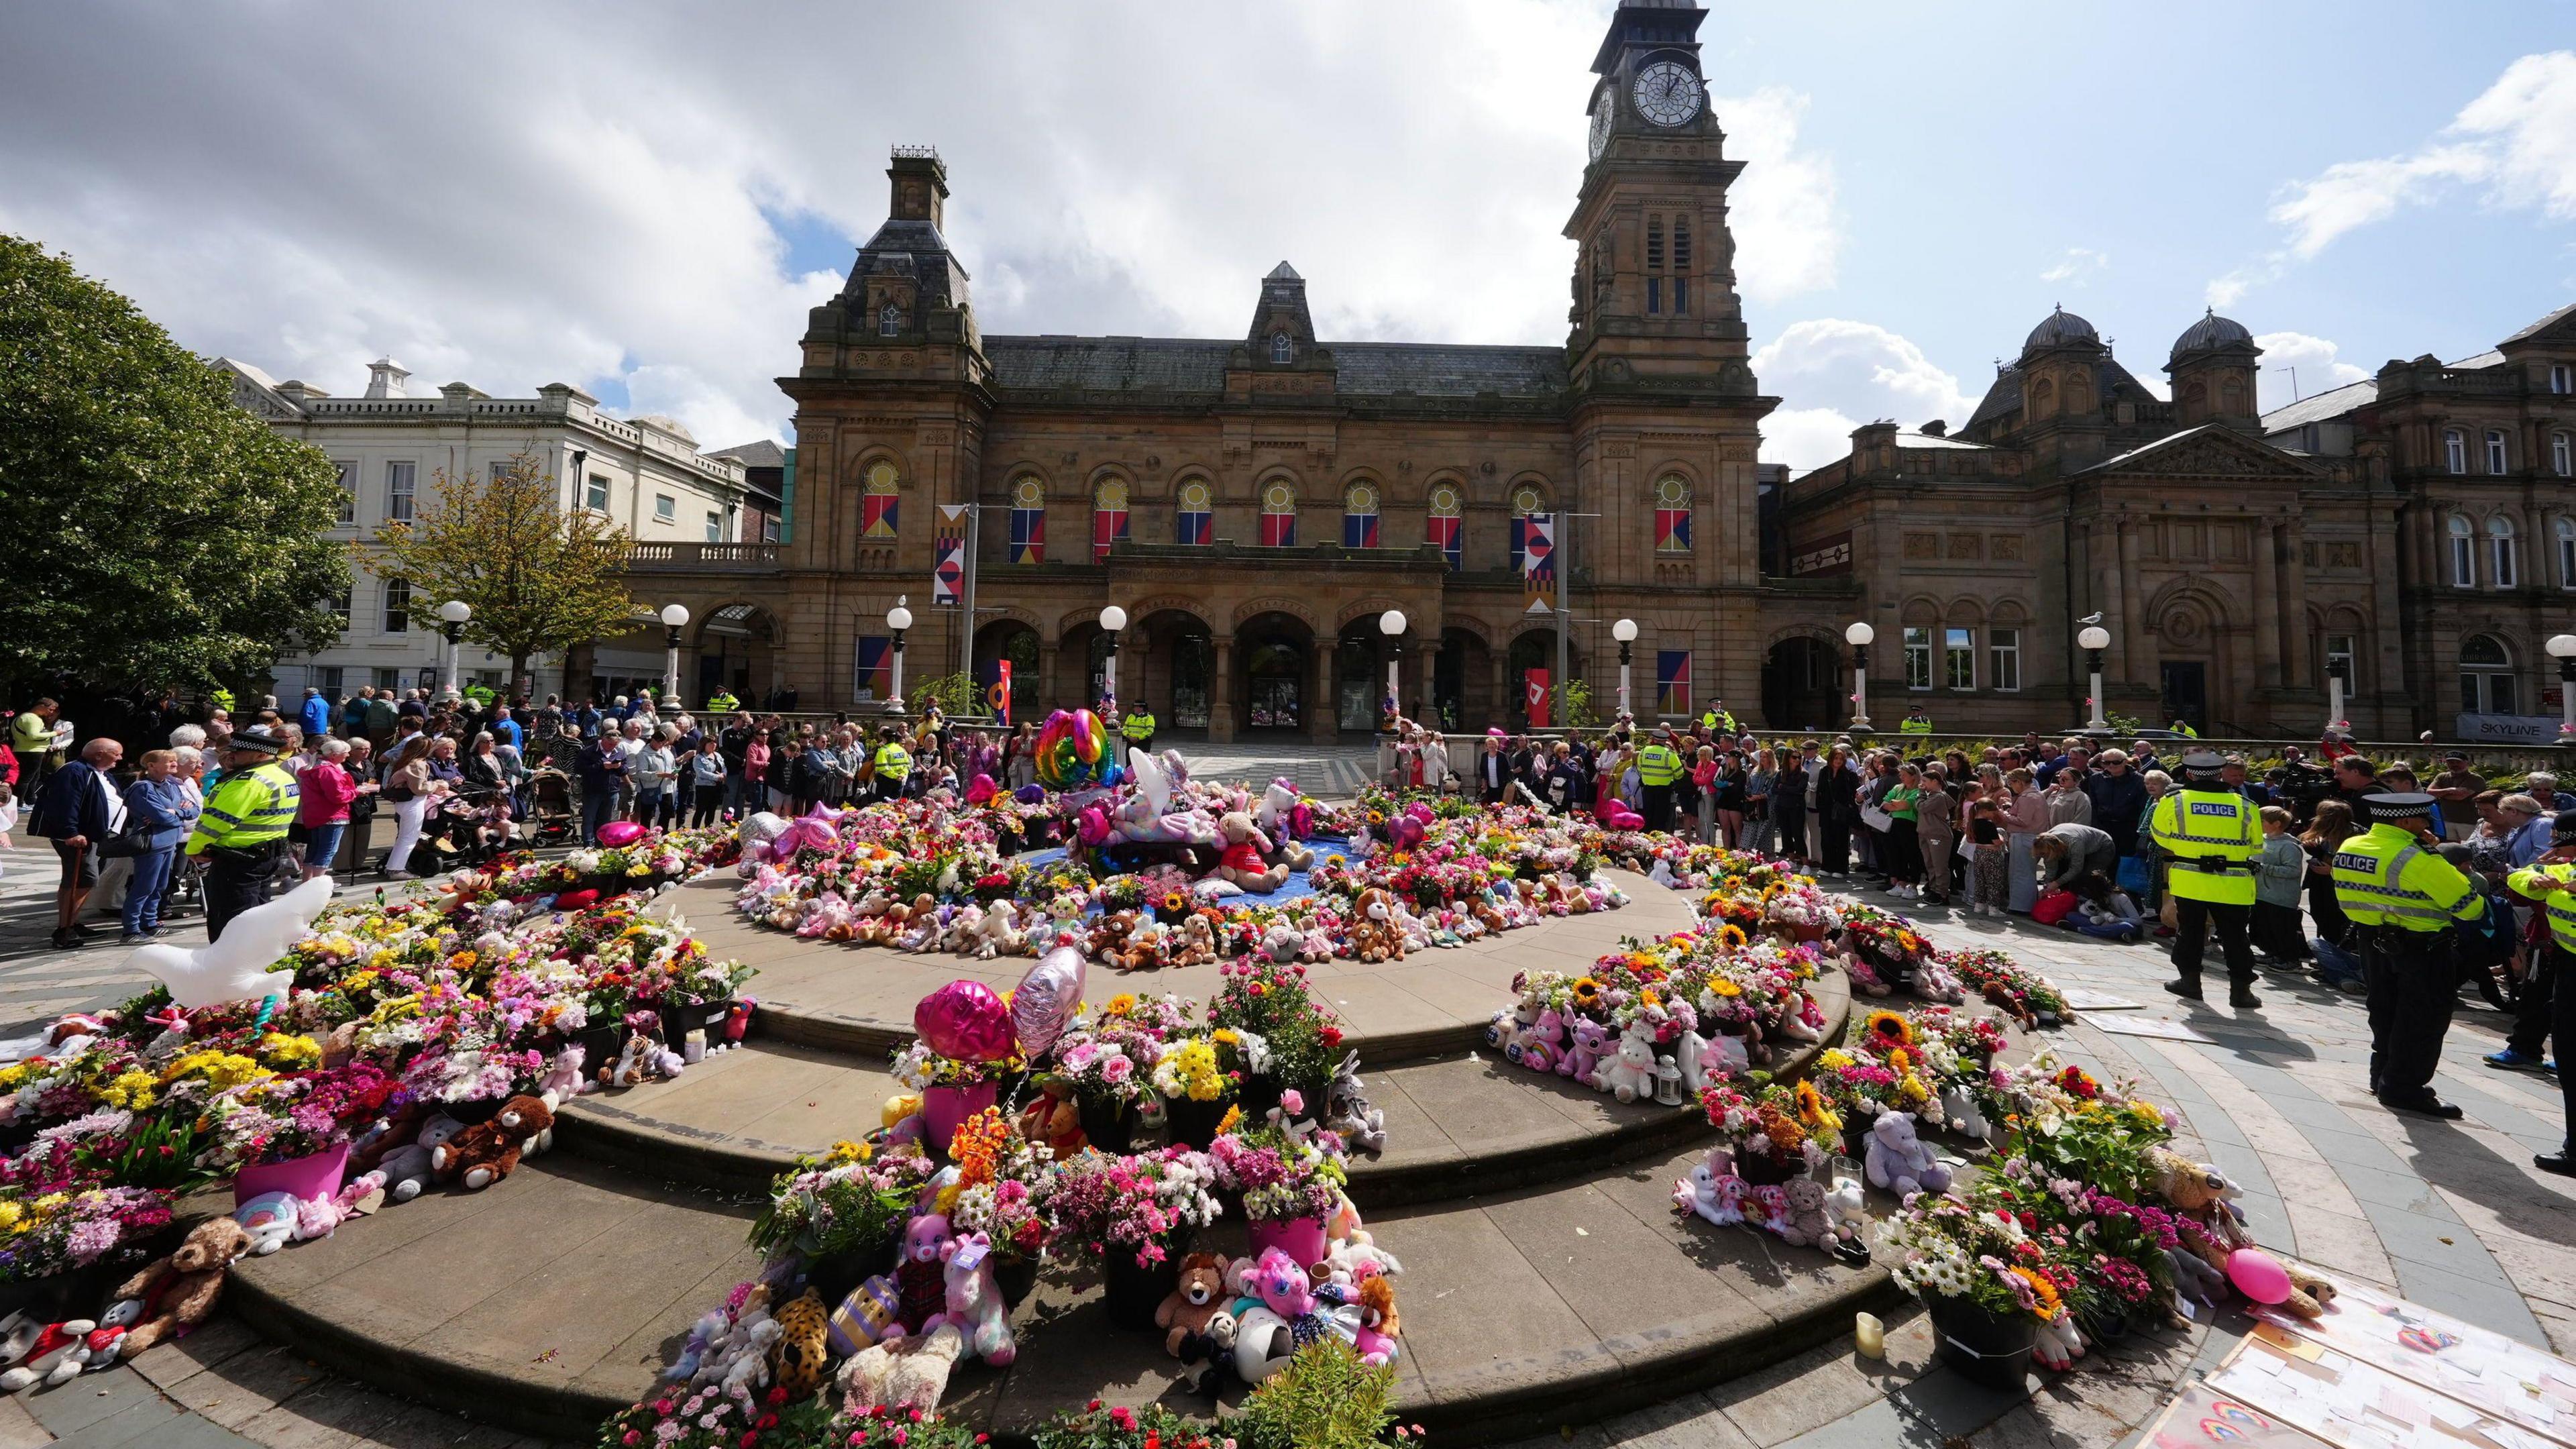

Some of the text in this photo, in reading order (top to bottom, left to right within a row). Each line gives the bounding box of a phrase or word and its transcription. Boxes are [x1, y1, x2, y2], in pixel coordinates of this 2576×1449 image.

[2481, 723, 2540, 736] SKYLINE
[2192, 804, 2235, 816] POLICE
[2333, 855, 2375, 871] POLICE
